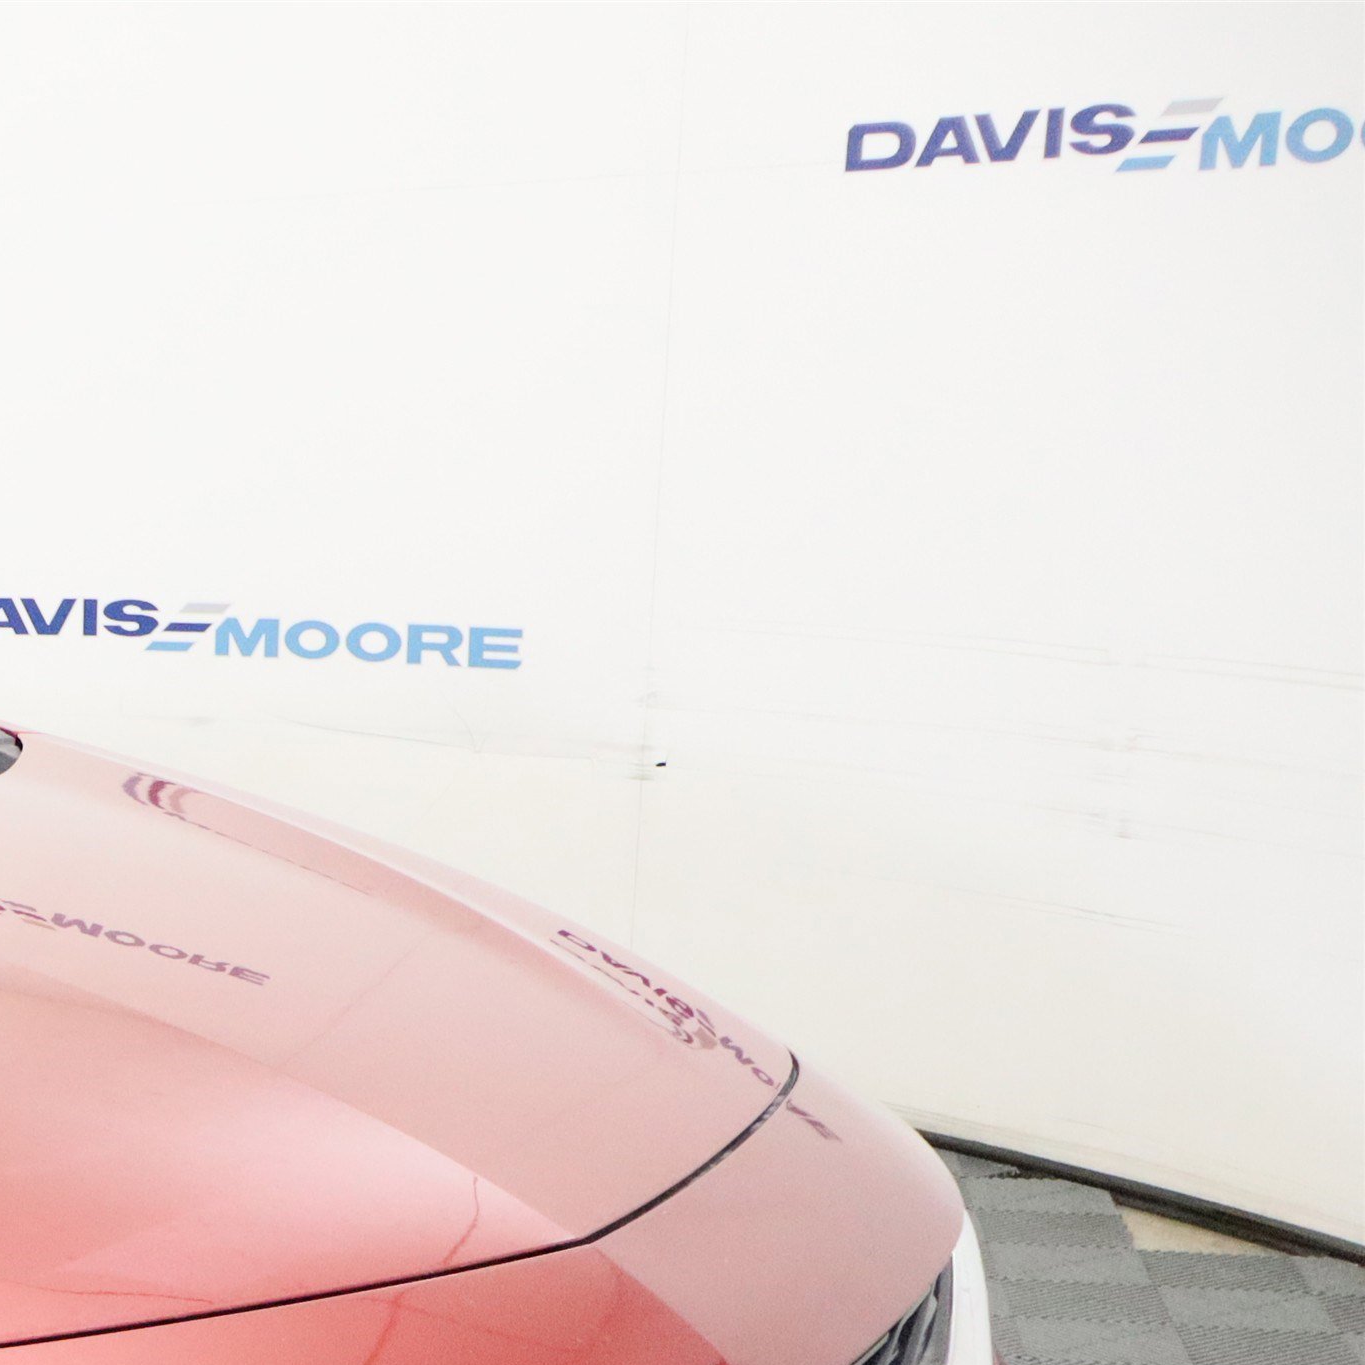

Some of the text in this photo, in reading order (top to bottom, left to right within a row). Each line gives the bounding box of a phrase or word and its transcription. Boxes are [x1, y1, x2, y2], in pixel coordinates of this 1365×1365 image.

[844, 103, 1365, 172] DAVIS MO
[214, 616, 523, 670] MOORE
